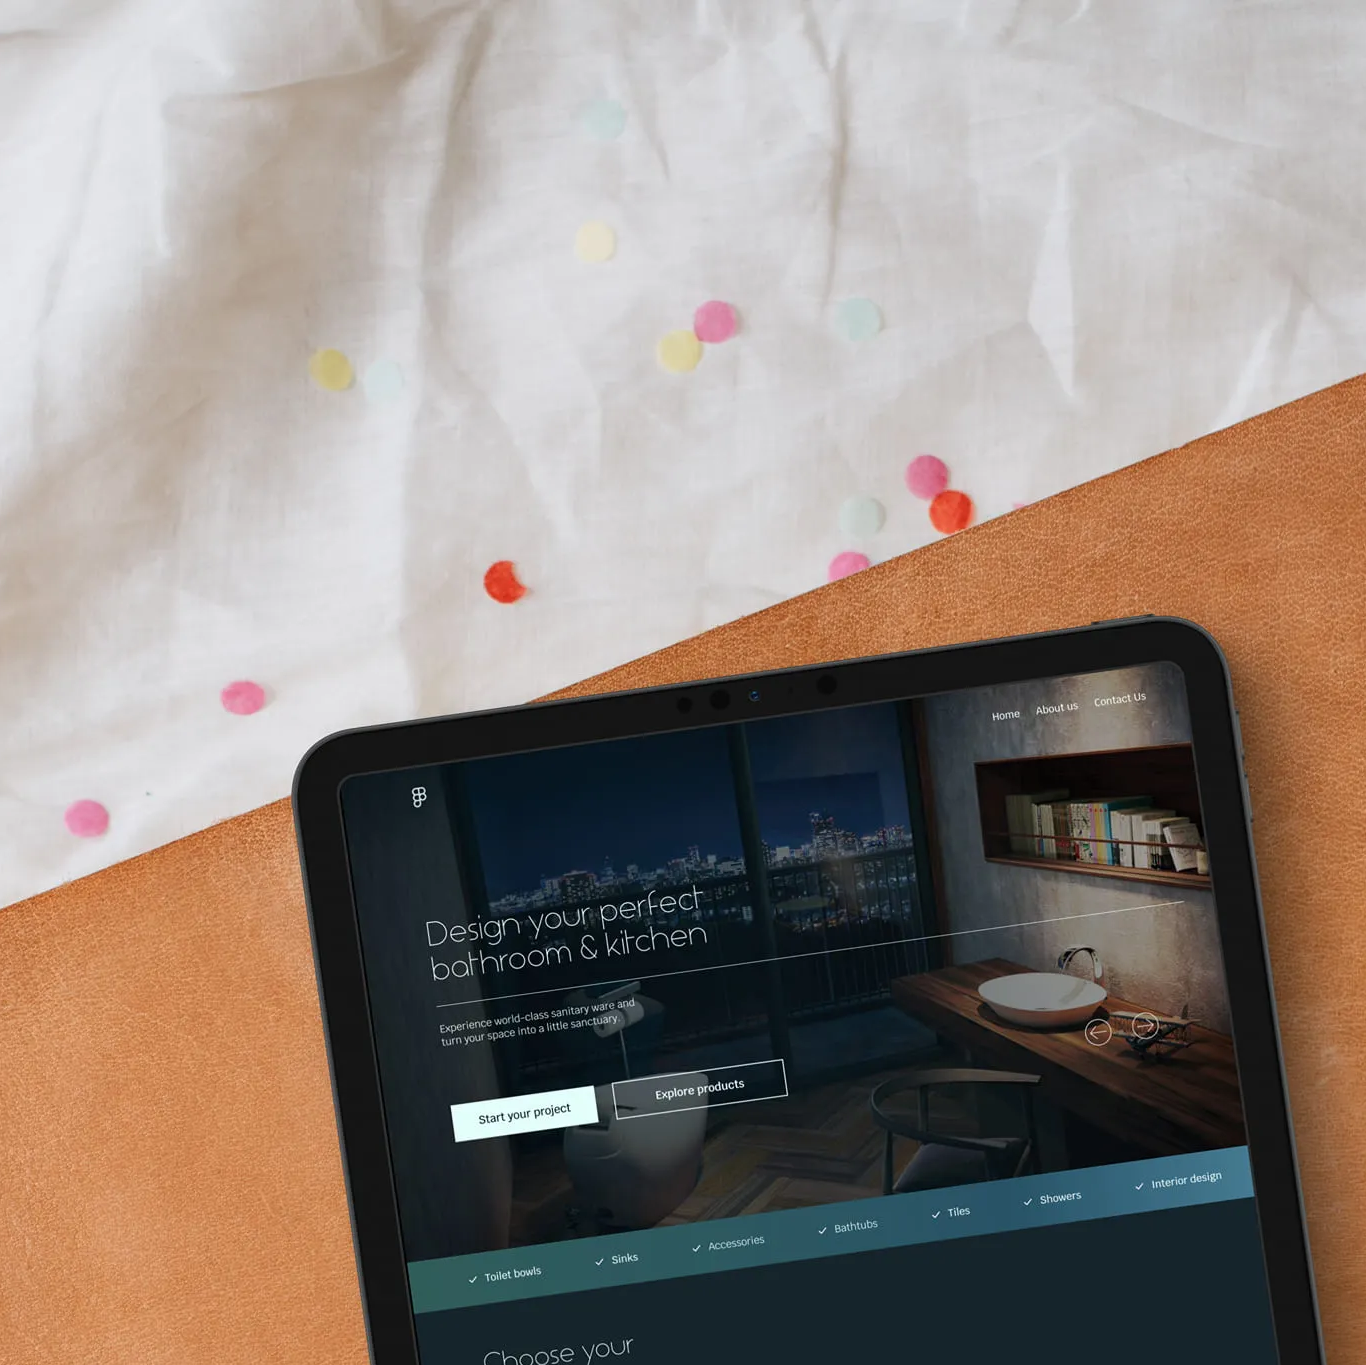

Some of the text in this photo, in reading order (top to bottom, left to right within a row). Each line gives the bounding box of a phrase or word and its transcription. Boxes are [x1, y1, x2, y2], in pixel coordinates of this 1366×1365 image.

[1094, 692, 1147, 707] Contact Us
[991, 709, 1021, 722] Home
[1035, 702, 1079, 716] About us
[425, 885, 704, 947] Design your perfect
[430, 926, 708, 981] bathroom & kitchen
[439, 998, 636, 1034] Experience world-class sanitary ware and
[441, 1014, 621, 1047] turn your space into a little sanctuary.
[655, 1078, 746, 1102] Explore products
[478, 1103, 572, 1125] Start your project
[1151, 1171, 1223, 1190] Interior design
[1039, 1190, 1082, 1206] Showers
[947, 1205, 971, 1218] Tiles
[834, 1218, 878, 1233] Bathtubs
[707, 1234, 765, 1252] Accessories
[611, 1252, 639, 1266] Sinks
[484, 1265, 542, 1283] Toilet bowls
